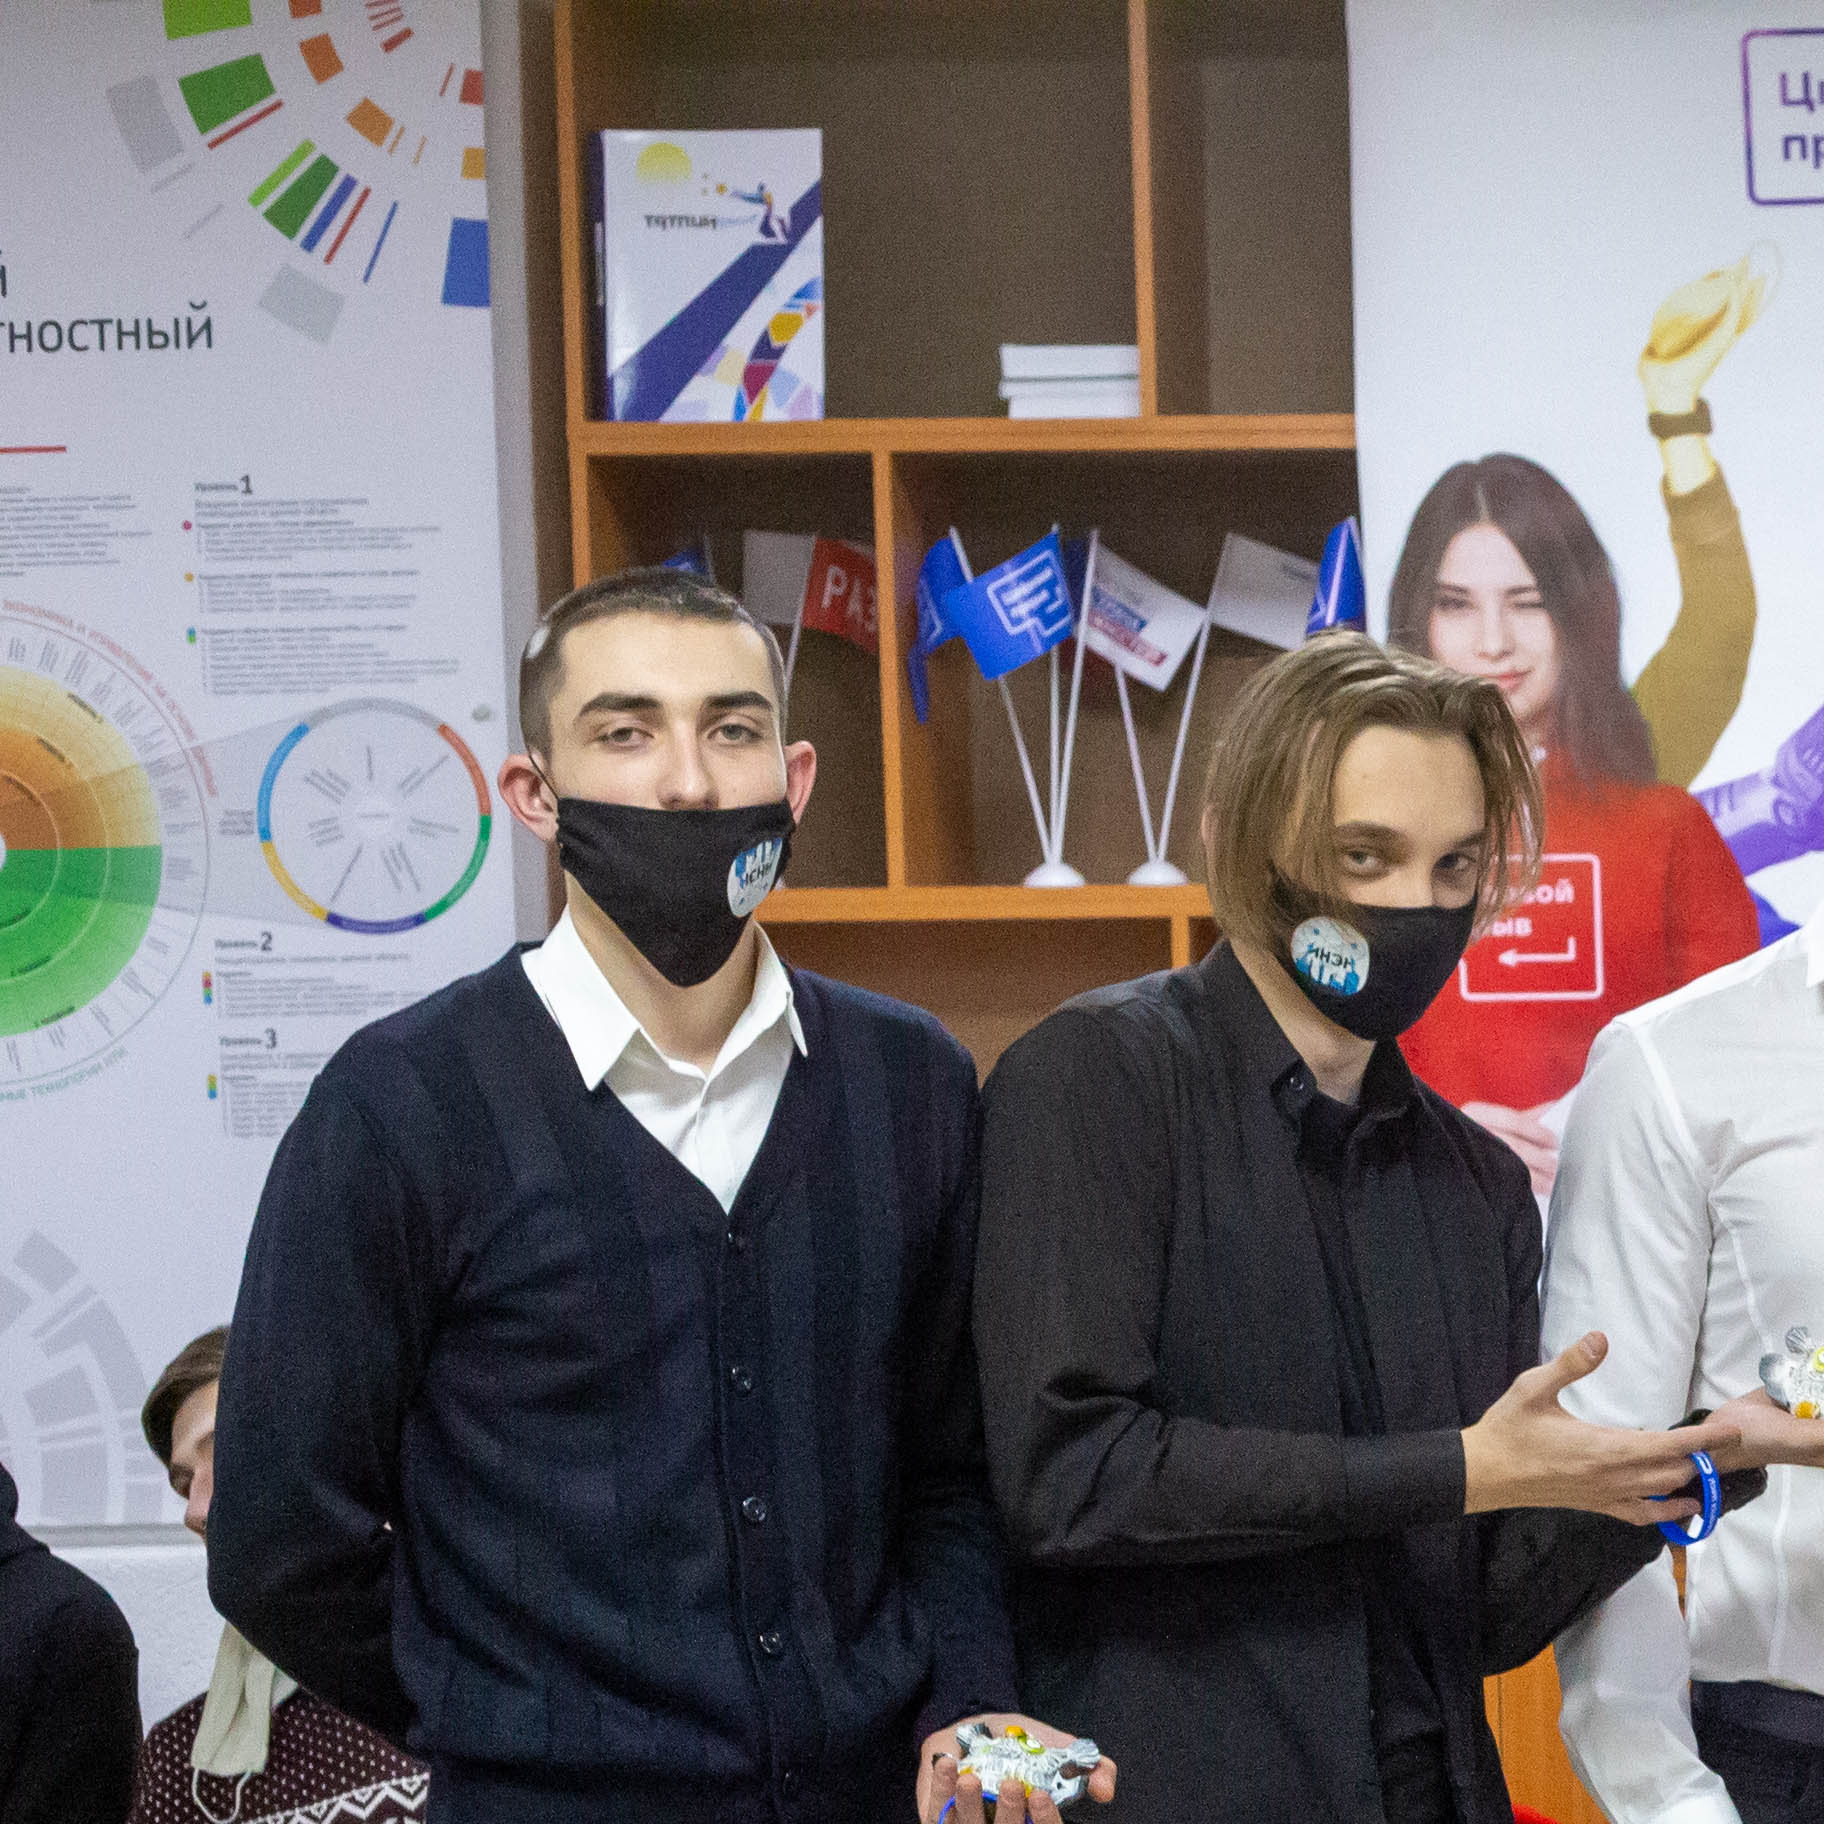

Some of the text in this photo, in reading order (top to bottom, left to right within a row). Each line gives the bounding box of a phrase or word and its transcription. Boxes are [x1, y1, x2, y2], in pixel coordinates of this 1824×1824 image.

[0, 300, 213, 353] НОСТНЫЙ
[240, 475, 254, 495] 1
[261, 931, 272, 951] 2
[264, 1027, 276, 1049] 3
